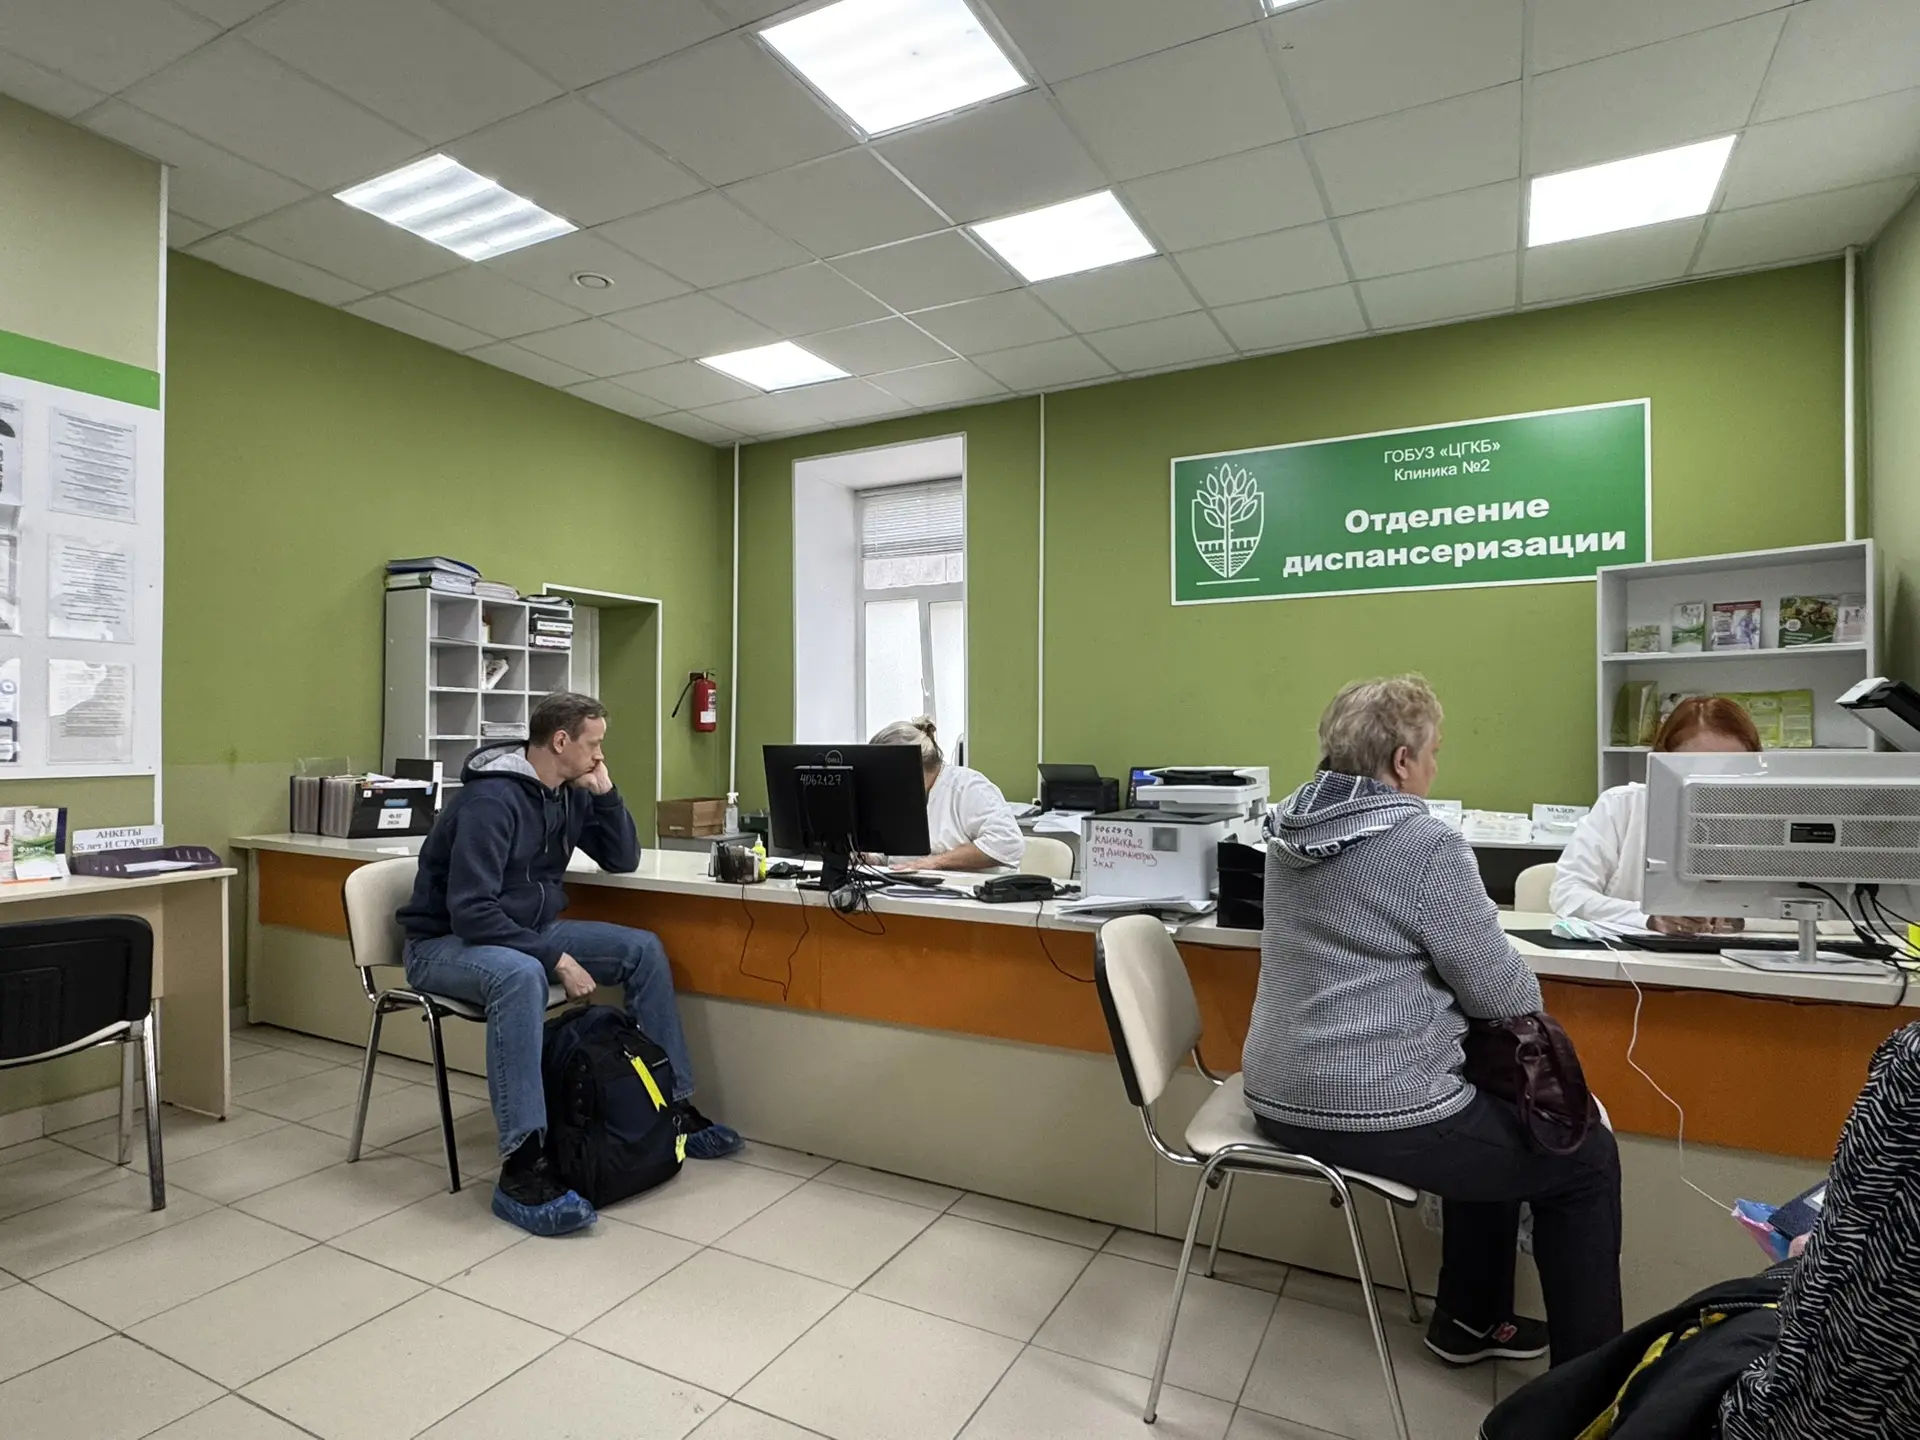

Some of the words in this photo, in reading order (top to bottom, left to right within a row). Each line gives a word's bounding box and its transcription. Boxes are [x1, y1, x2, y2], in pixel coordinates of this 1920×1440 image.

[1384, 446, 1435, 463] ГОБУЗ
[1440, 439, 1501, 458] «ЦГКБ»
[1394, 465, 1457, 481] Клиника
[1462, 459, 1490, 474] №2
[1344, 498, 1550, 535] Отделение
[1283, 530, 1626, 578] диспансеризации
[800, 773, 842, 786] 4062127
[96, 828, 142, 838] АНКЕТЫ
[115, 837, 159, 848] СТАРШЕ
